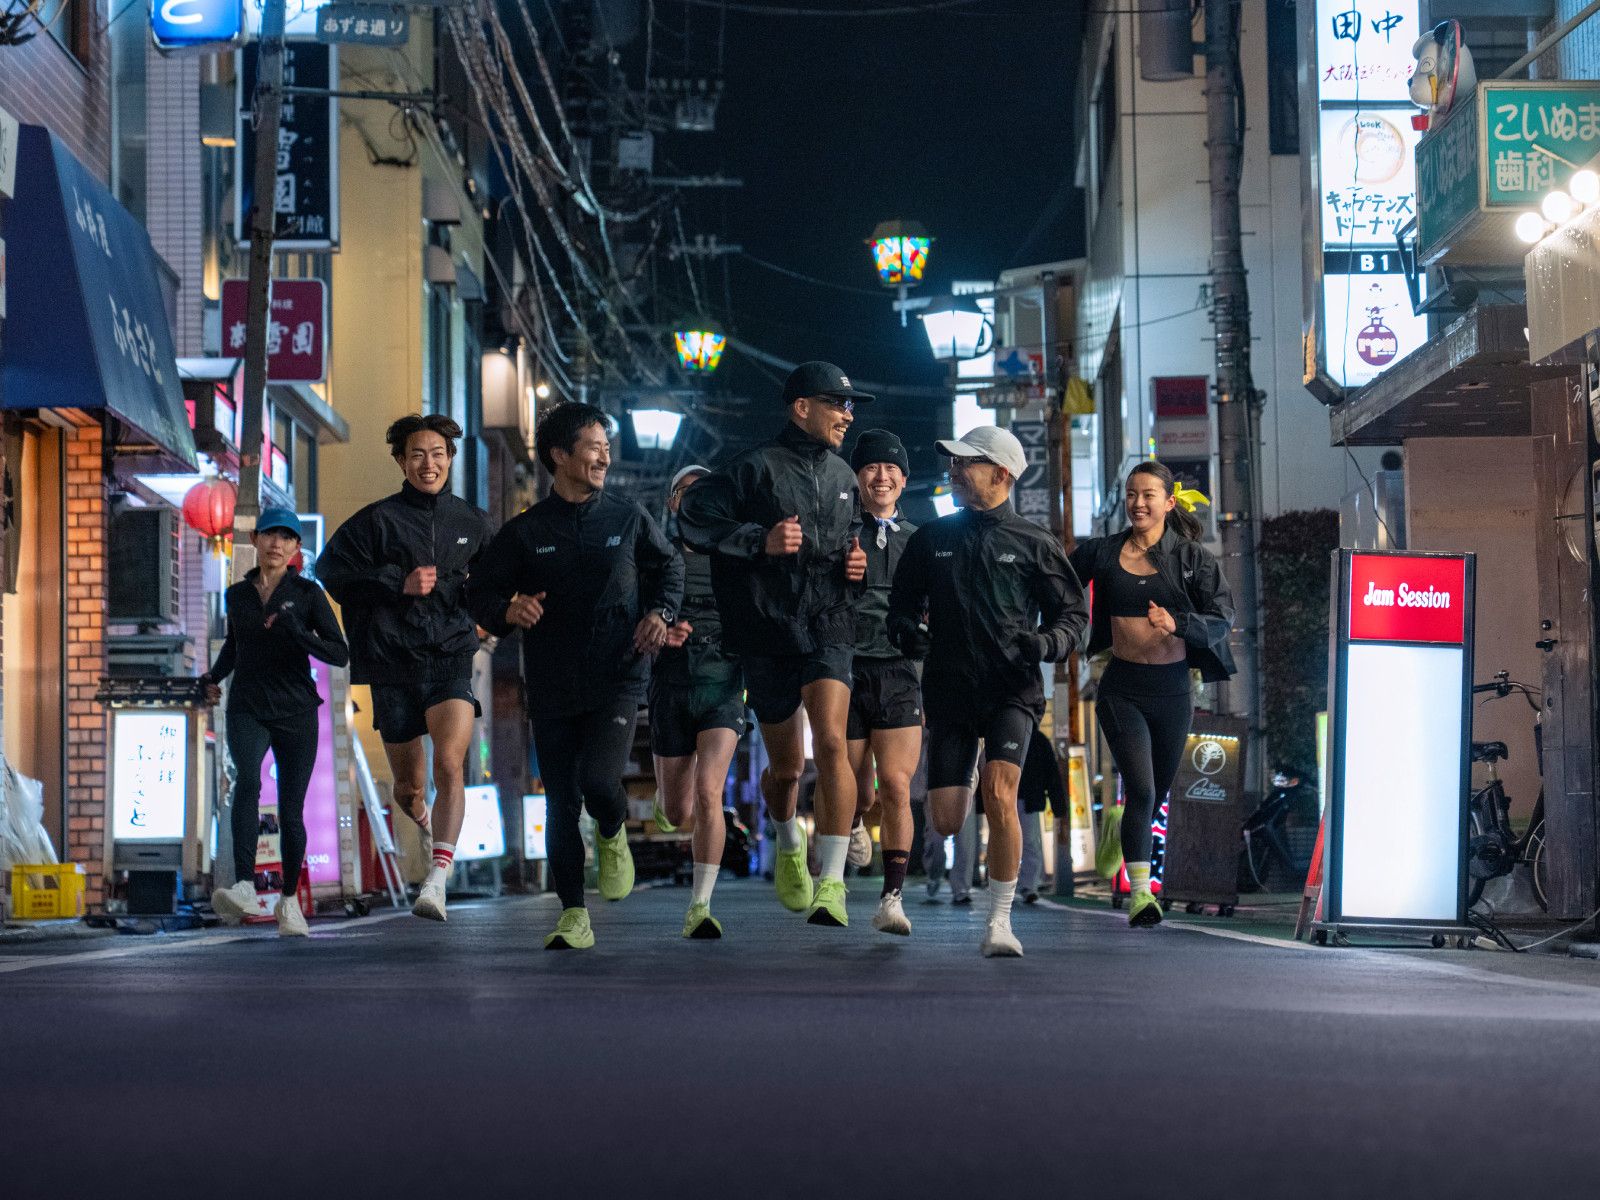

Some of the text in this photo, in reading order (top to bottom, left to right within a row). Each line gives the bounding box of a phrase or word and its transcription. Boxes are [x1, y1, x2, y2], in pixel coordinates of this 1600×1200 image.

[324, 16, 404, 36] あずま通り
[1332, 10, 1403, 44] 田中
[1494, 102, 1600, 141] こいぬま
[1494, 150, 1556, 192] 歯科
[1326, 191, 1416, 214] キャプテンズ
[1336, 216, 1402, 236] ドーナツ
[1364, 582, 1450, 608] Jam Session
